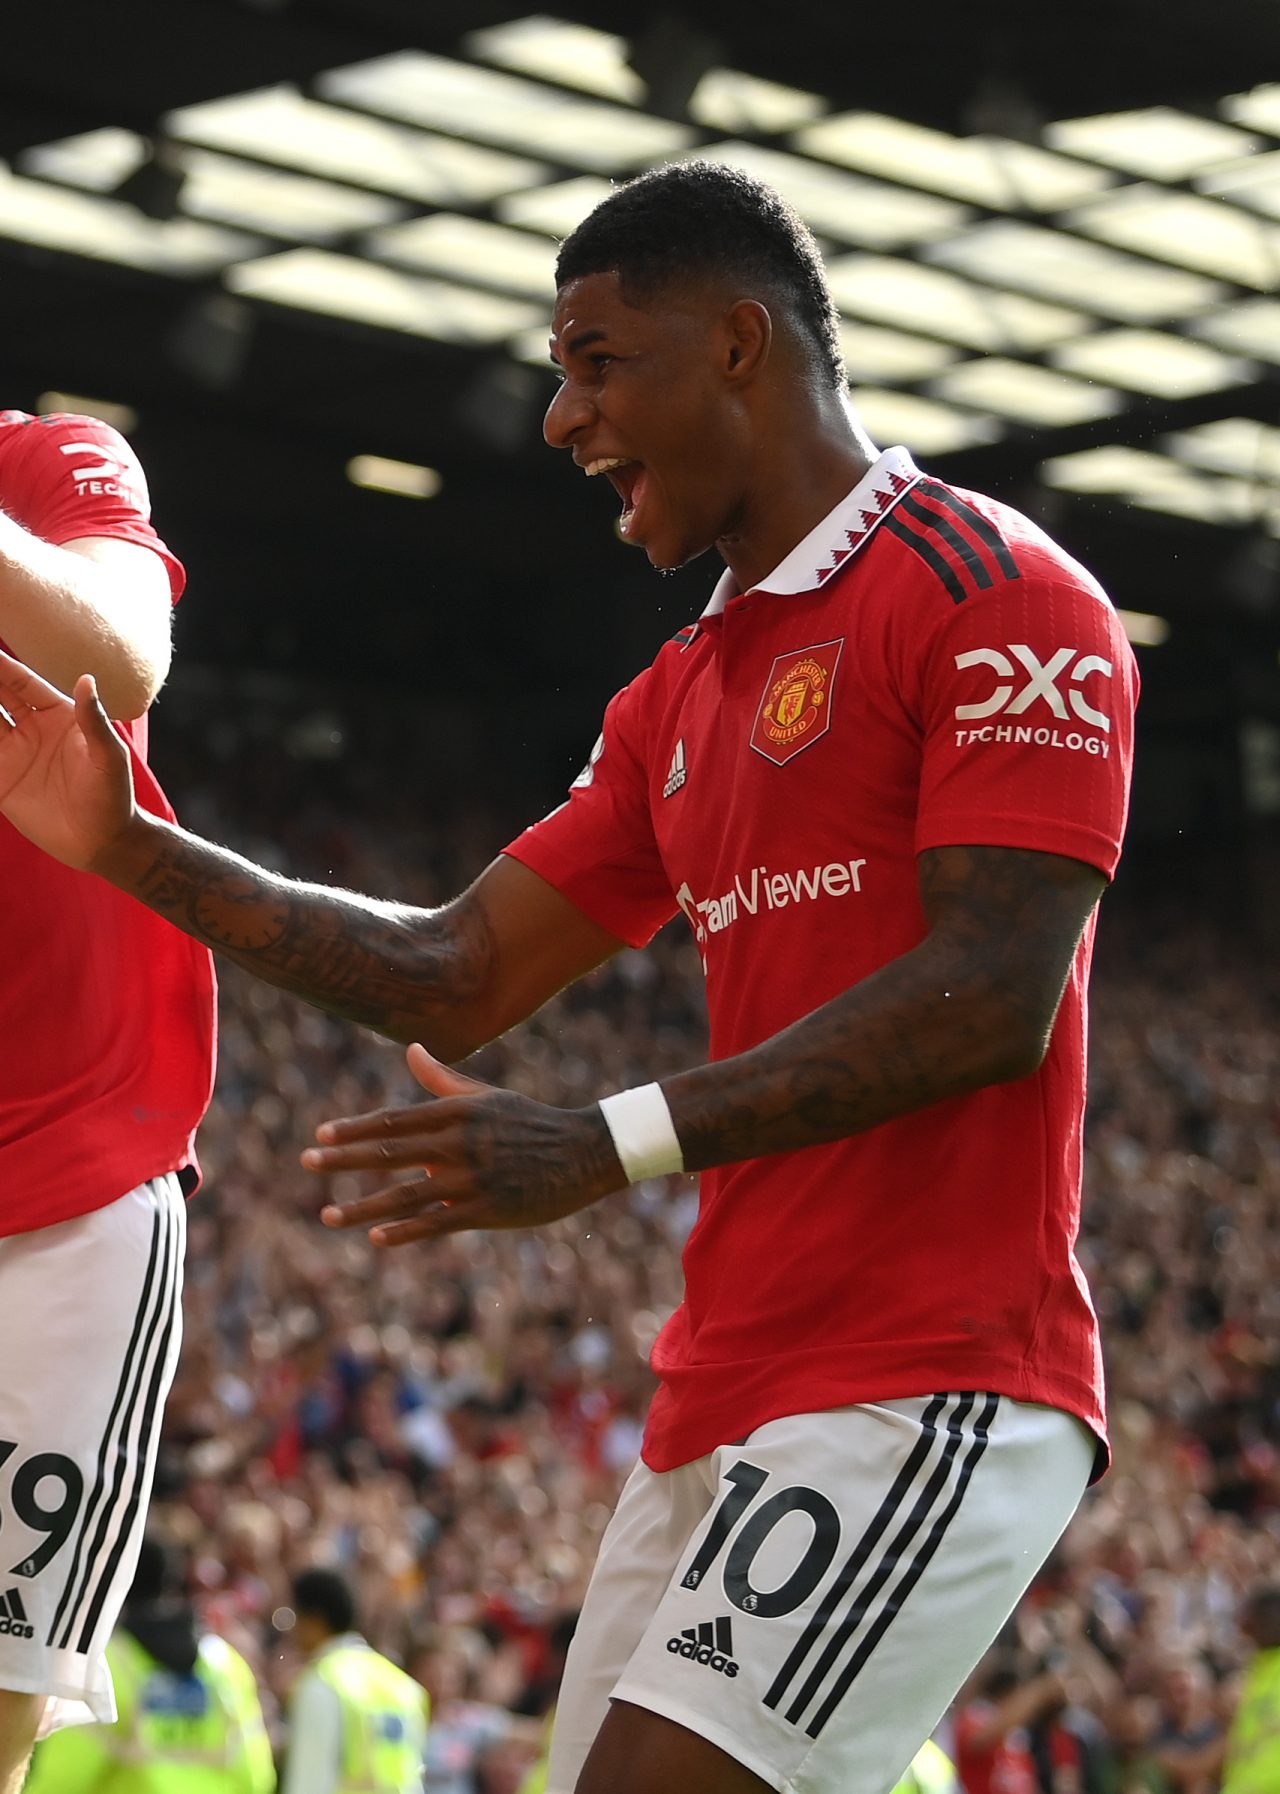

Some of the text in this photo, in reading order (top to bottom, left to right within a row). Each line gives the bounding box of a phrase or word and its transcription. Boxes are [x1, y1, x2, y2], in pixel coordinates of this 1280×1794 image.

[954, 644, 1112, 733] DXC
[769, 720, 807, 738] UNITED
[955, 725, 1109, 758] TECHNOLOGY
[680, 1460, 841, 1618] 10
[666, 1636, 740, 1678] adidas
